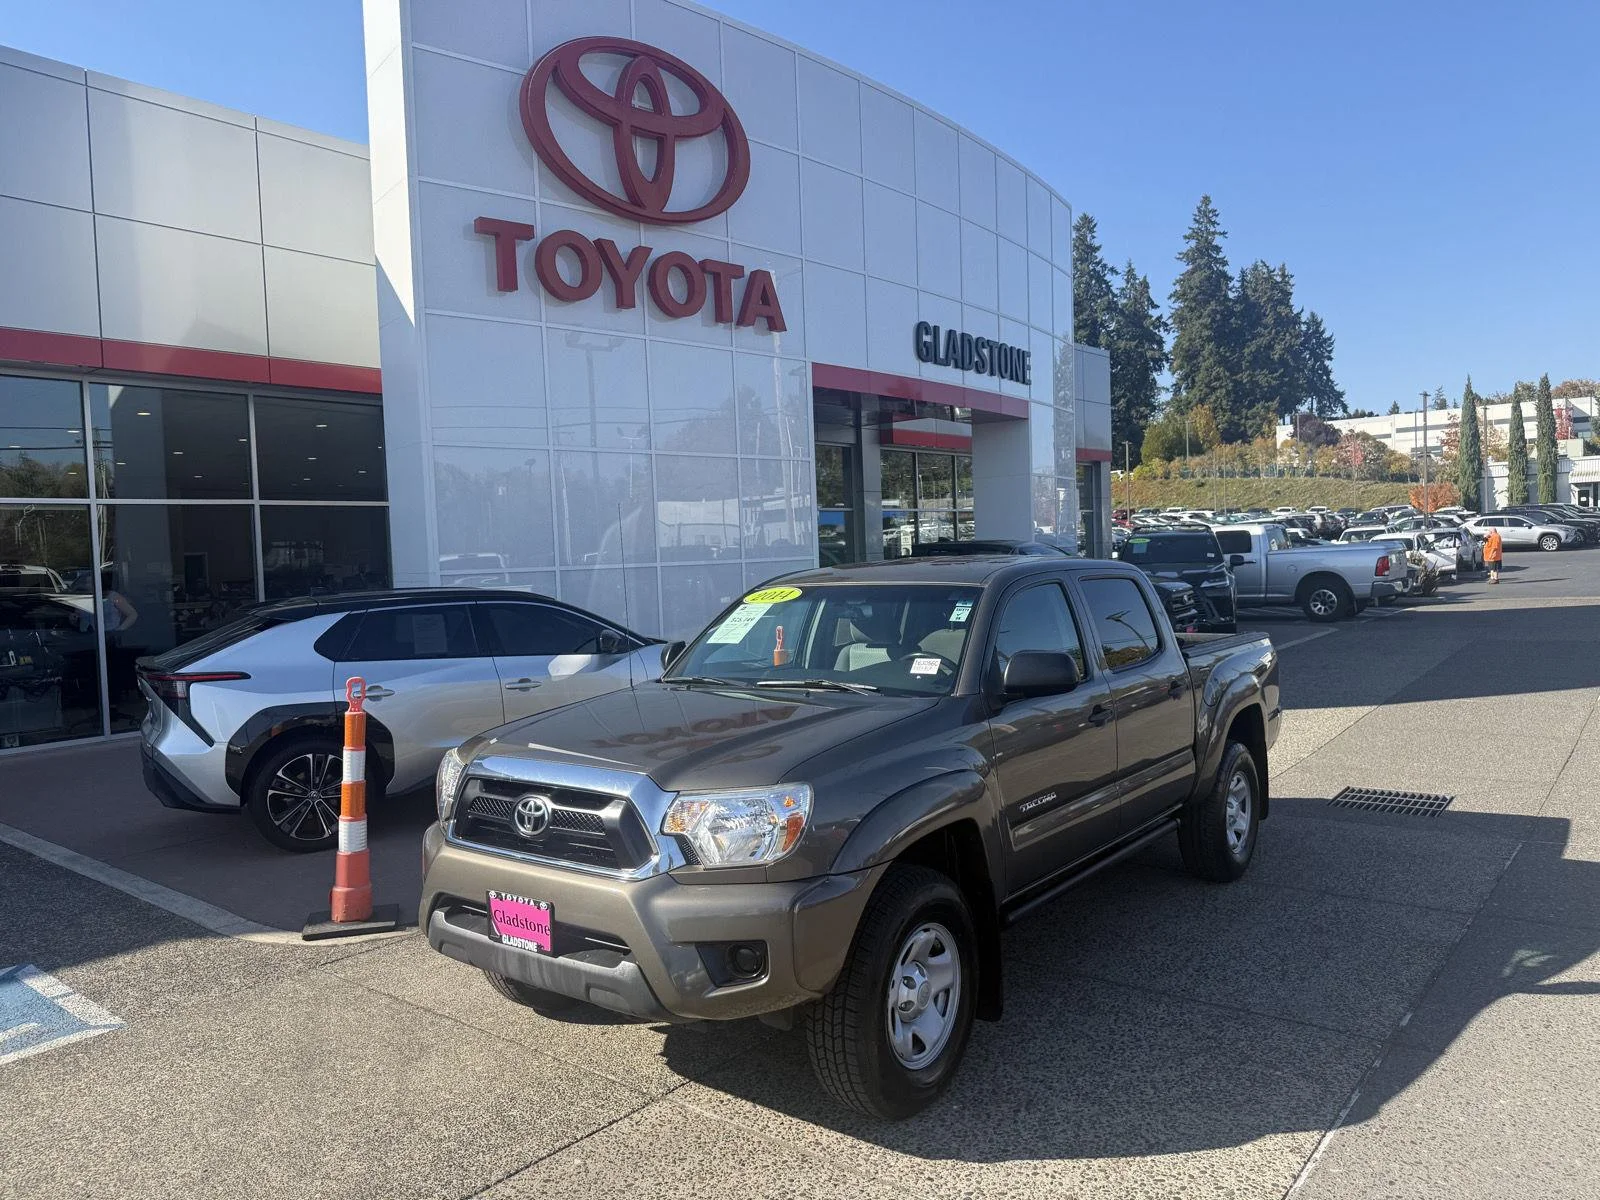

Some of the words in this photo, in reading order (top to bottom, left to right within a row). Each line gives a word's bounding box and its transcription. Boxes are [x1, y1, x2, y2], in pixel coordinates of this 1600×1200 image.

[474, 216, 787, 332] TOYOTA
[914, 321, 1031, 385] GLADSTONE
[501, 893, 535, 906] TOYOTA
[494, 909, 551, 936] Gladstone
[502, 934, 538, 952] GLADSTONE
